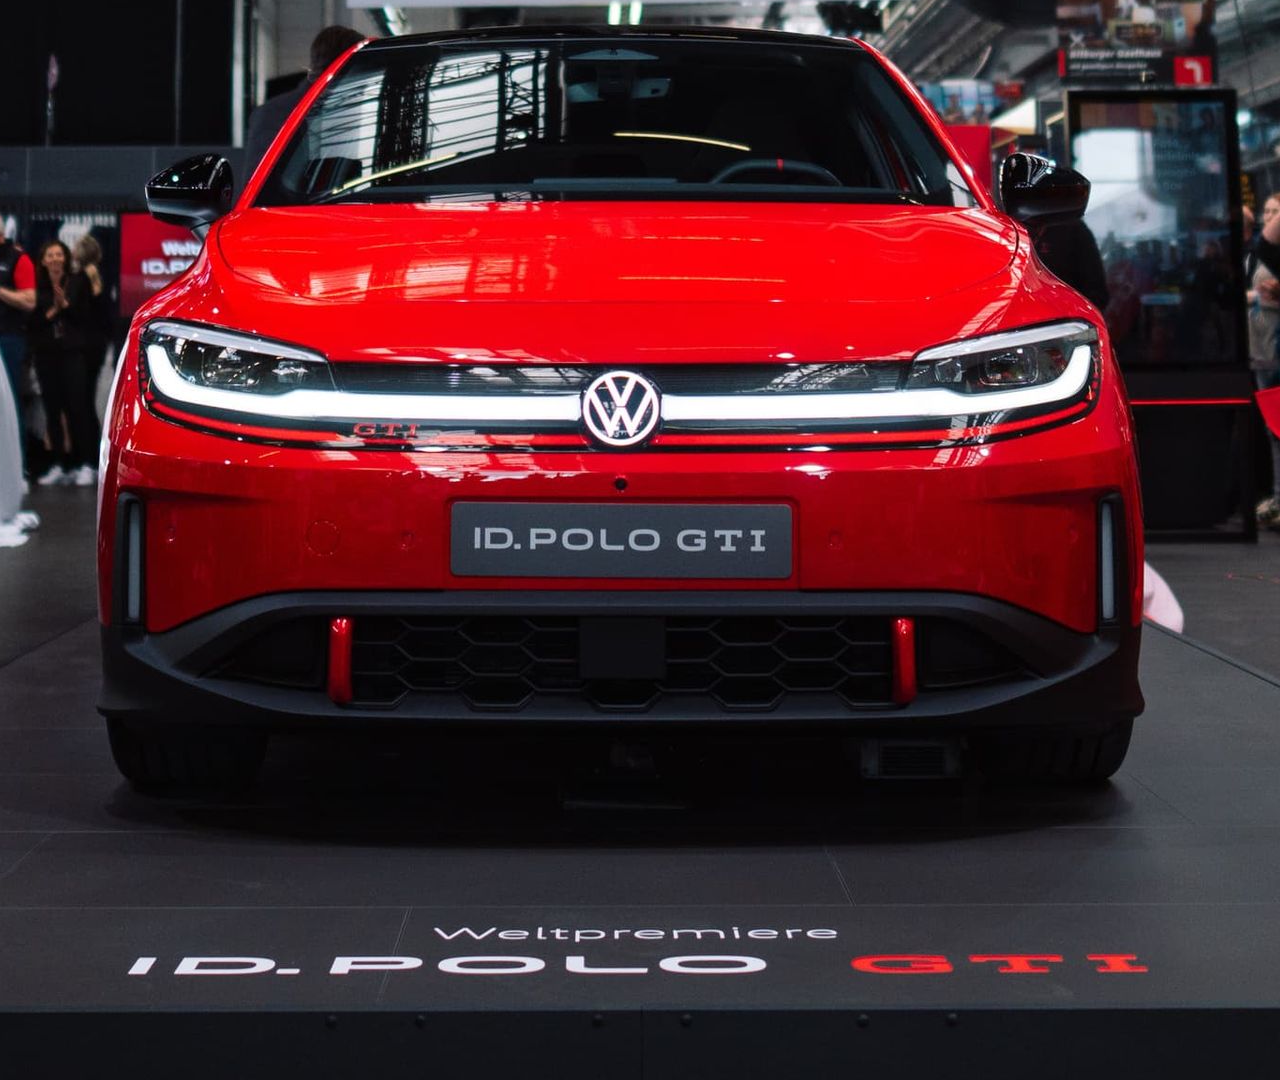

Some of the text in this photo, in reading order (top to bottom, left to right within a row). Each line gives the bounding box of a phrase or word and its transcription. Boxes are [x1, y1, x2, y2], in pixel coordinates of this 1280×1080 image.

[141, 258, 196, 275] ID.P
[352, 422, 421, 438] GTI
[675, 527, 767, 553] GTI
[433, 924, 839, 943] Weltpremiere
[850, 953, 1149, 975] GTI
